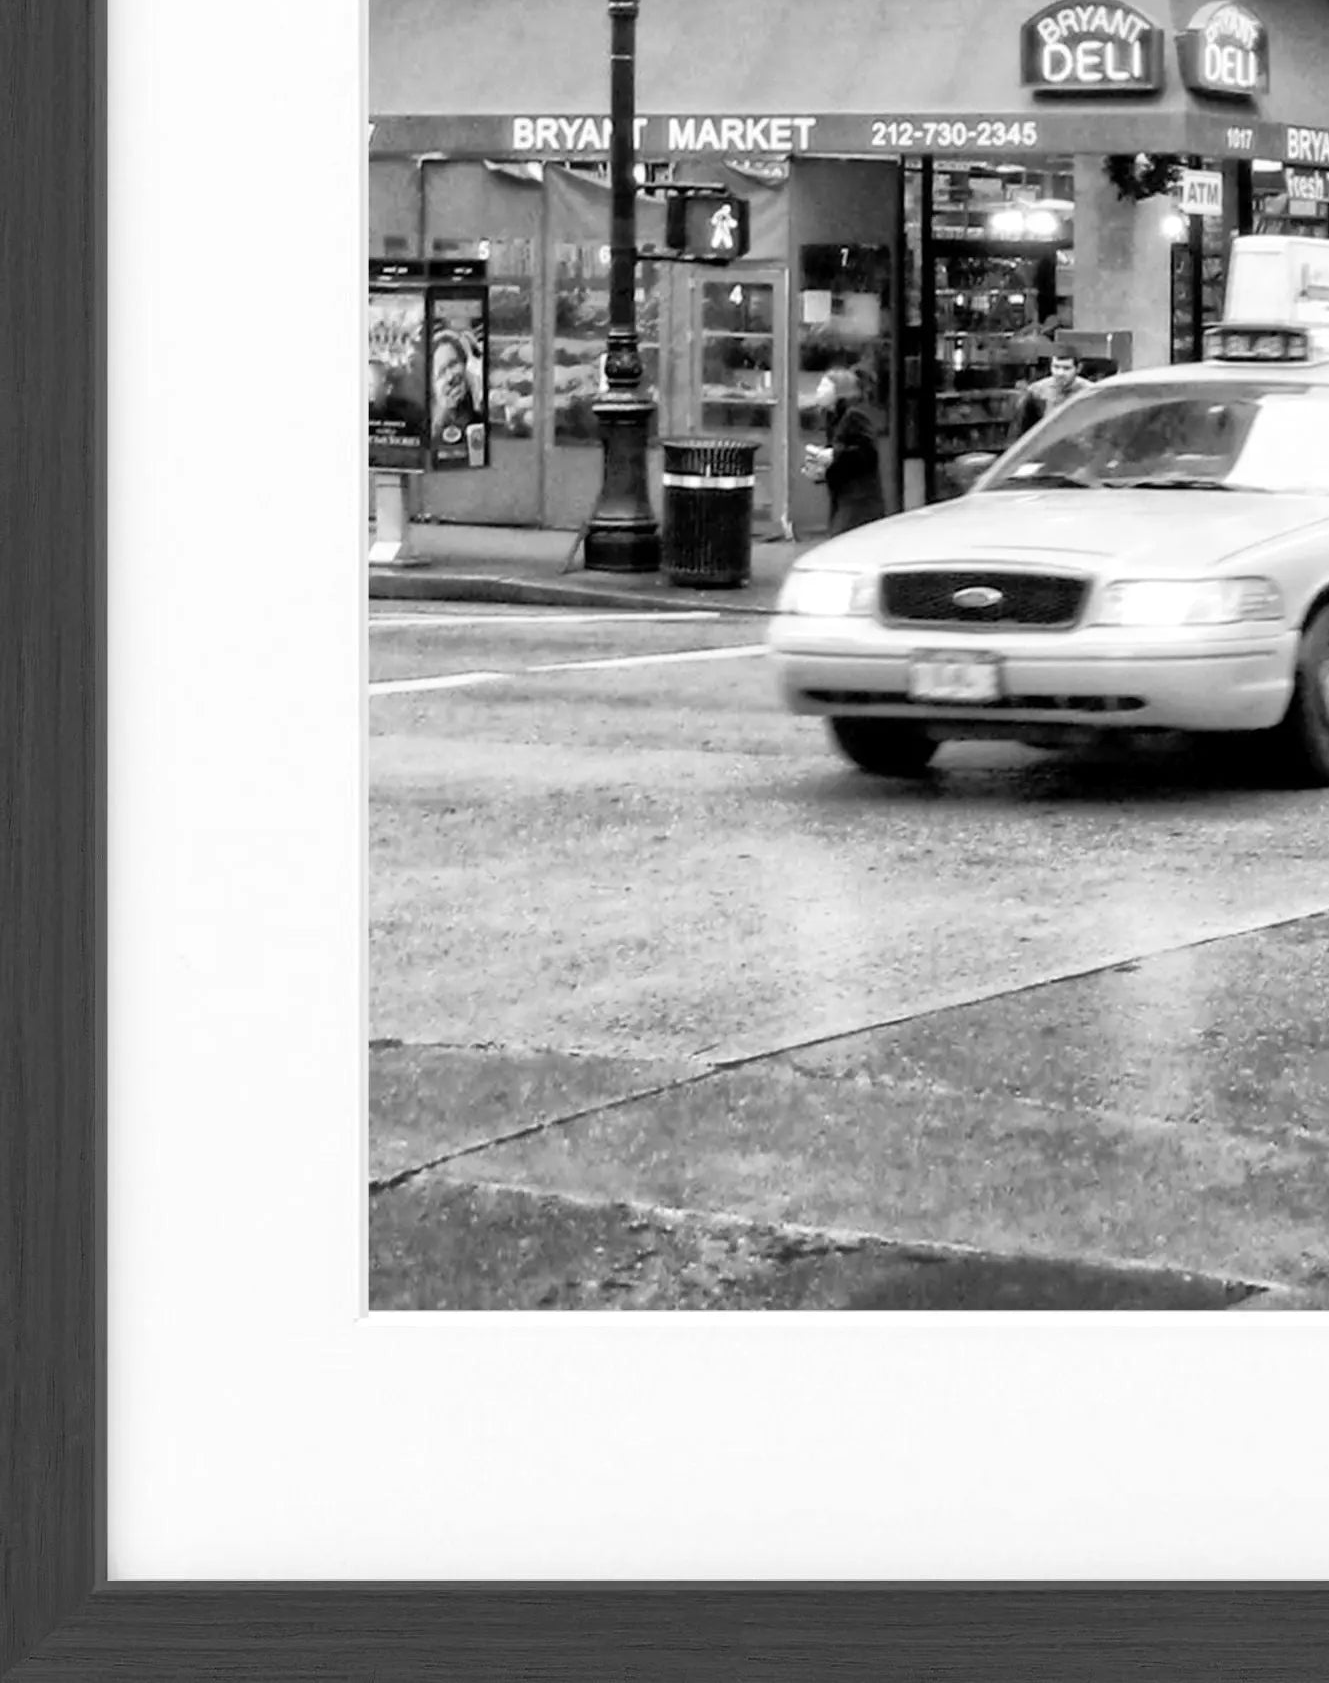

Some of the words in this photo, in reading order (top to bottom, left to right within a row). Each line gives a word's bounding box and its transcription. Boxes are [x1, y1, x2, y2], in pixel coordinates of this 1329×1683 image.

[1036, 5, 1151, 45] BRYANT
[1042, 40, 1143, 83] DELI
[1204, 43, 1257, 87] DELI
[667, 117, 816, 150] MARKET
[870, 120, 1038, 147] 212-730-2345
[1227, 127, 1253, 150] 1017
[1188, 181, 1221, 205] ATM
[1285, 167, 1324, 200] Fresh
